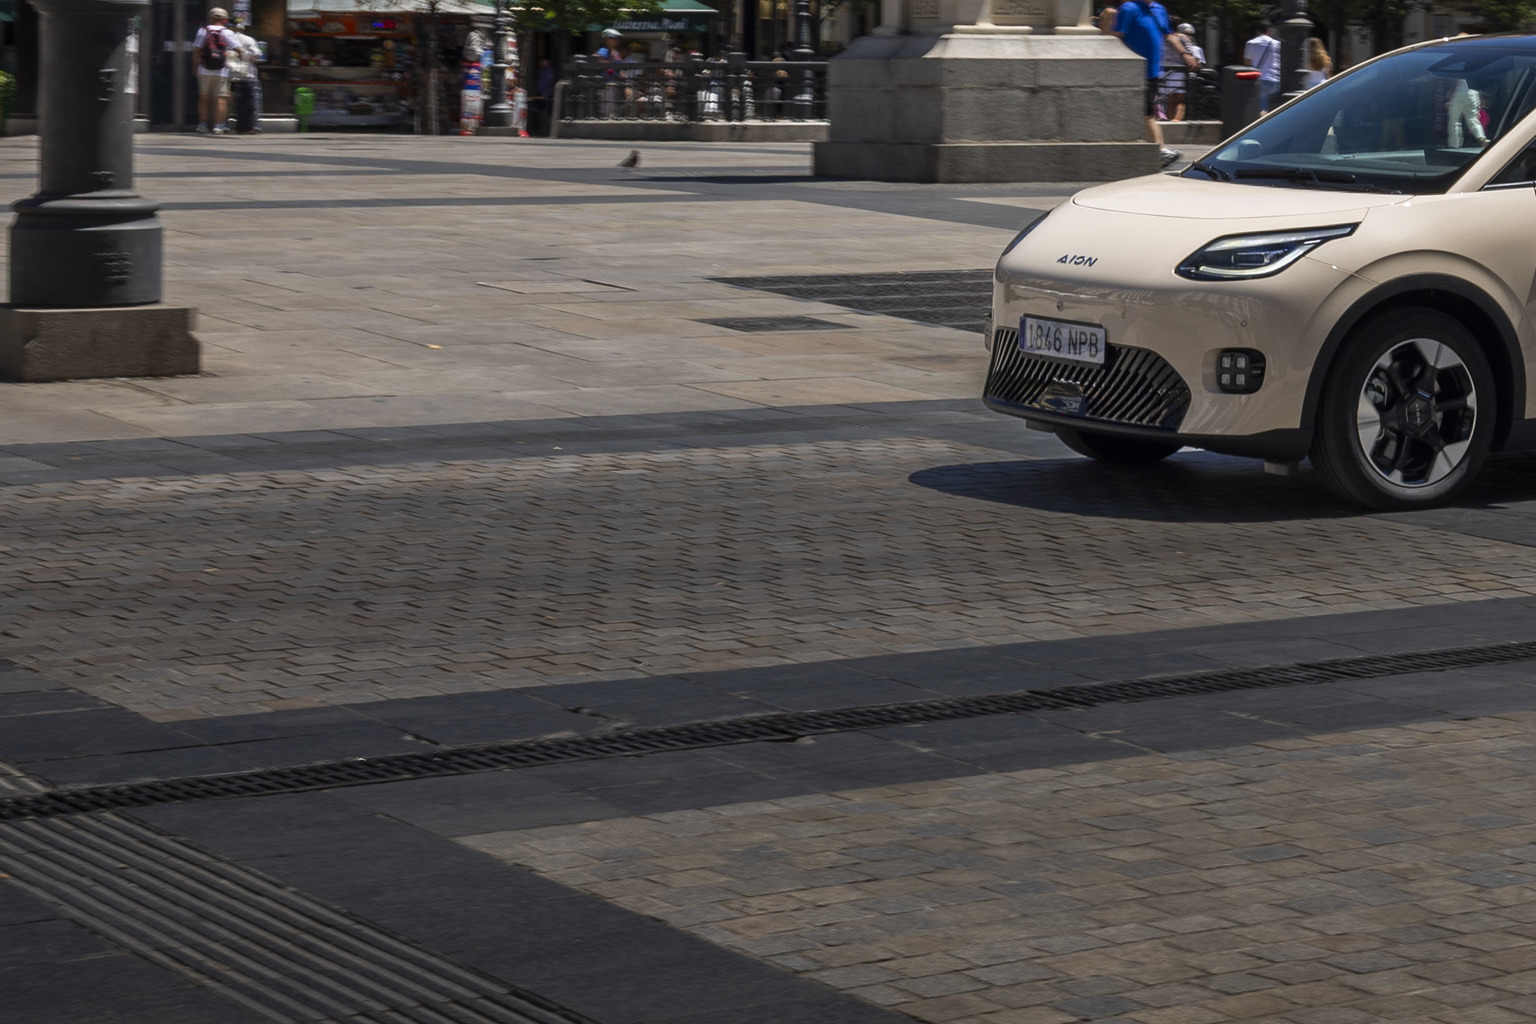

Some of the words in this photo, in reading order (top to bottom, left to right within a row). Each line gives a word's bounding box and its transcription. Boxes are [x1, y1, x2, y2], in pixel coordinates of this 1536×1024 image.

[1057, 254, 1098, 267] AION
[1029, 323, 1062, 352] 1846
[1067, 329, 1099, 358] NPB
